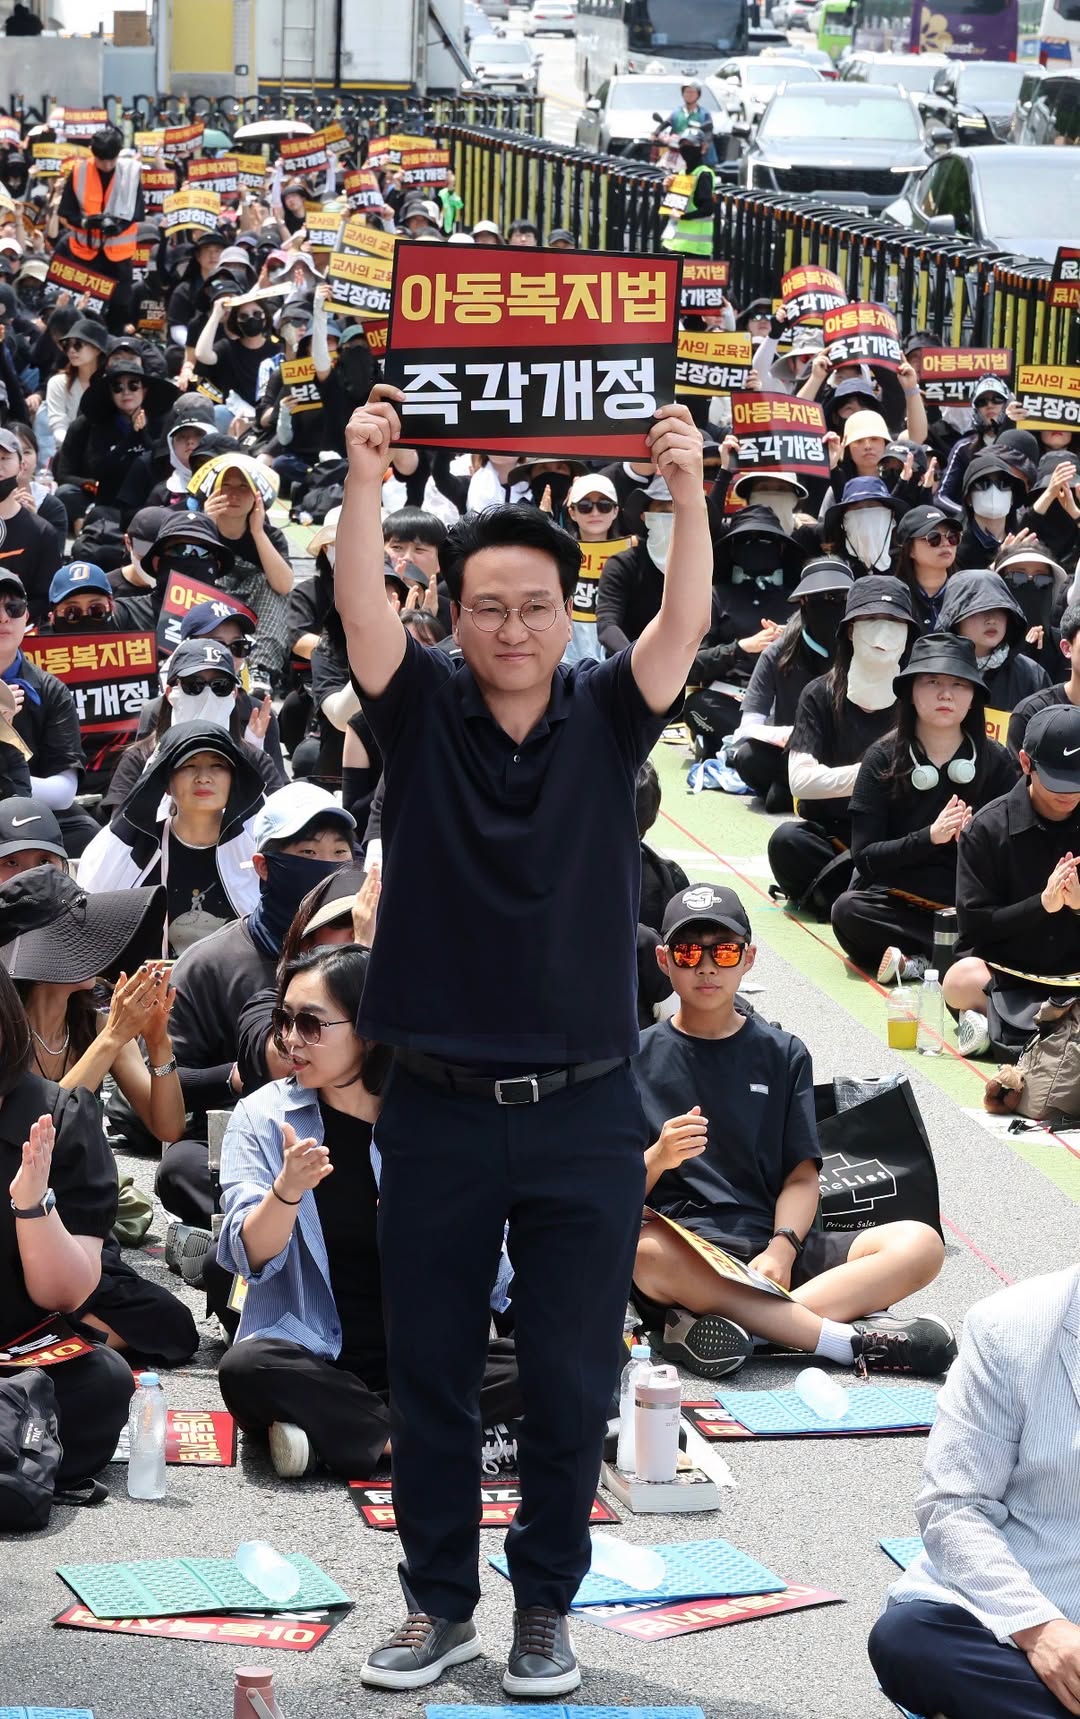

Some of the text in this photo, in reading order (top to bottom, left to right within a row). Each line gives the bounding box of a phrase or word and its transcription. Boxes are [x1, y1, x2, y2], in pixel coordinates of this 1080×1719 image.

[403, 168, 448, 183] 즉각개정
[166, 208, 217, 230] 보장하라
[344, 227, 377, 247] 교사의
[50, 259, 116, 296] 아동복지법
[331, 258, 371, 278] 교사의
[331, 279, 391, 311] 보장하
[401, 271, 667, 325] 아동복지법
[712, 344, 750, 359] 교육권
[829, 335, 901, 362] 즉각개정
[923, 354, 1009, 373] 아동복지법
[401, 357, 658, 426] 즉각개정
[1020, 373, 1064, 390] 교사의
[734, 401, 824, 427] 아동복지법
[737, 436, 826, 463] 즉각개정
[574, 582, 599, 608] 장
[172, 1411, 223, 1462] 아동복지법
